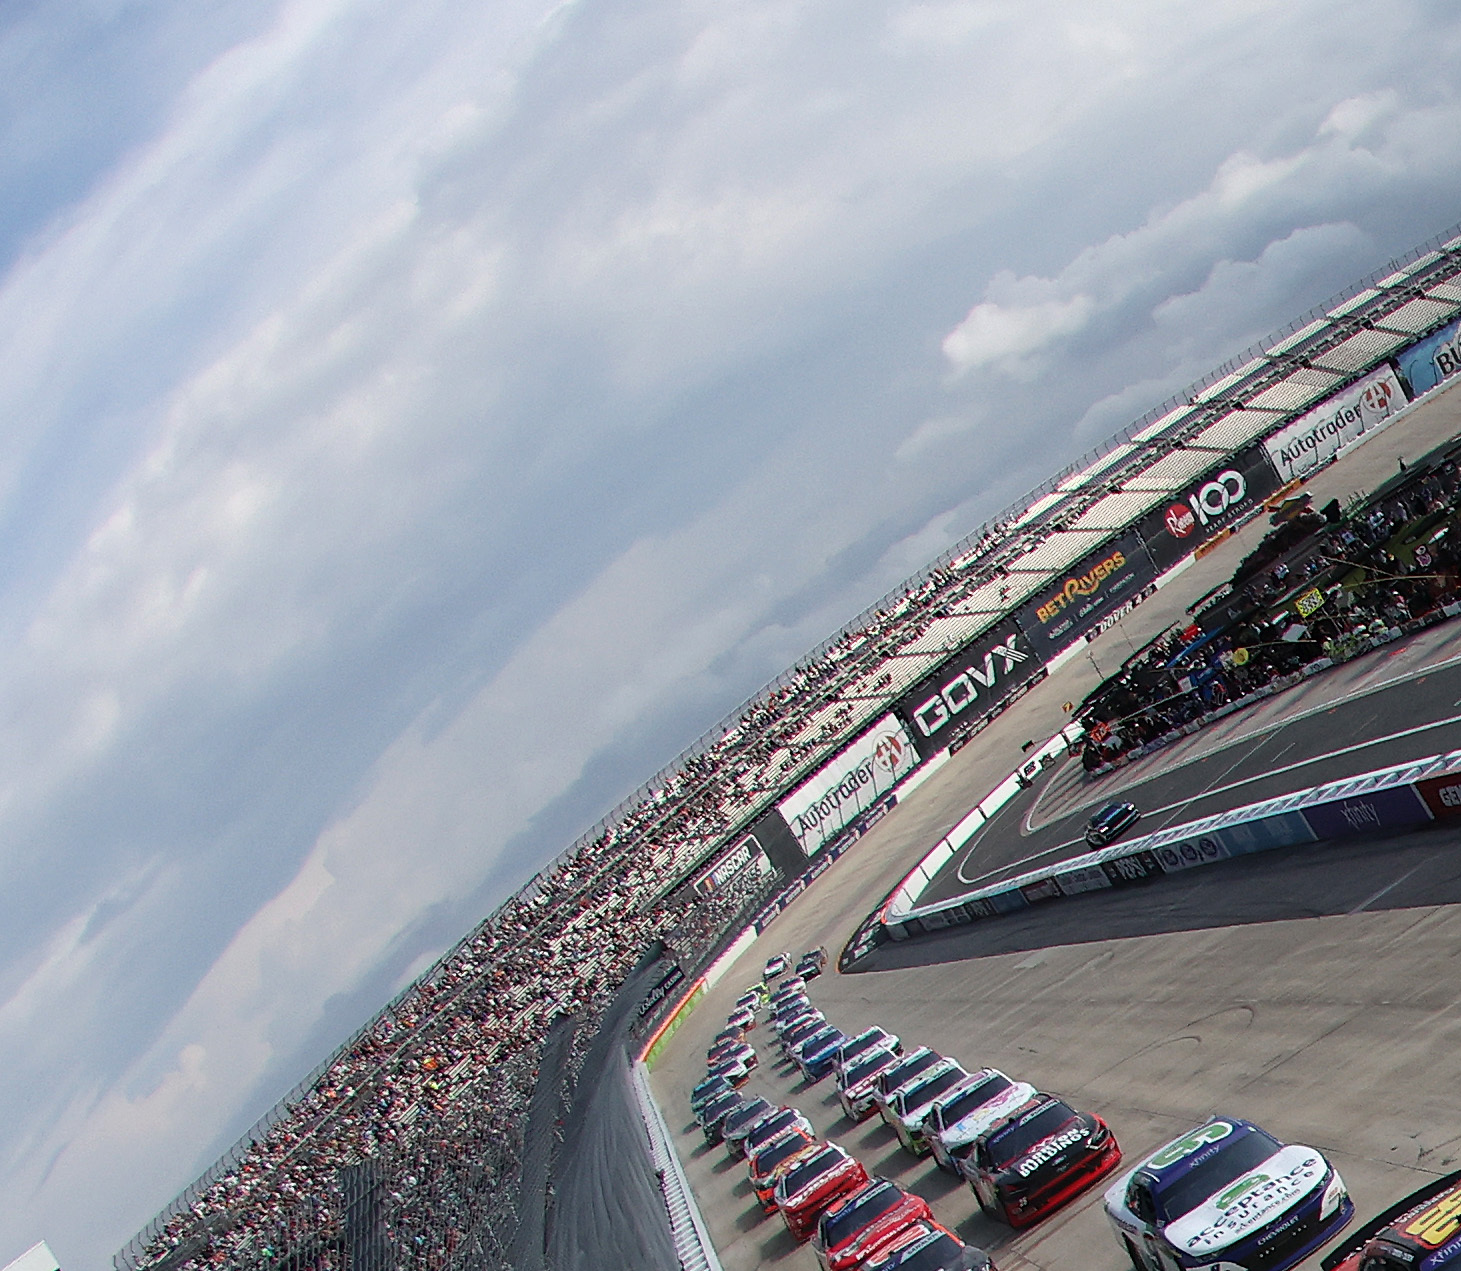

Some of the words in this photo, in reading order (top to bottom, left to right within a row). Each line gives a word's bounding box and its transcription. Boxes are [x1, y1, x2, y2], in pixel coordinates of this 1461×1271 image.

[1279, 404, 1362, 467] Autotrader
[1190, 470, 1248, 526] 100
[913, 633, 1029, 737] GOVX
[798, 760, 874, 834] Autotrader
[1340, 800, 1381, 830] xfinity
[715, 846, 753, 884] NASCAR
[1018, 1127, 1091, 1179] BUILDINGS
[1189, 1144, 1222, 1169] xfinity
[1184, 1157, 1319, 1249] acceptance
[1201, 1170, 1315, 1245] insurance
[1255, 1213, 1301, 1248] CHEVROLET
